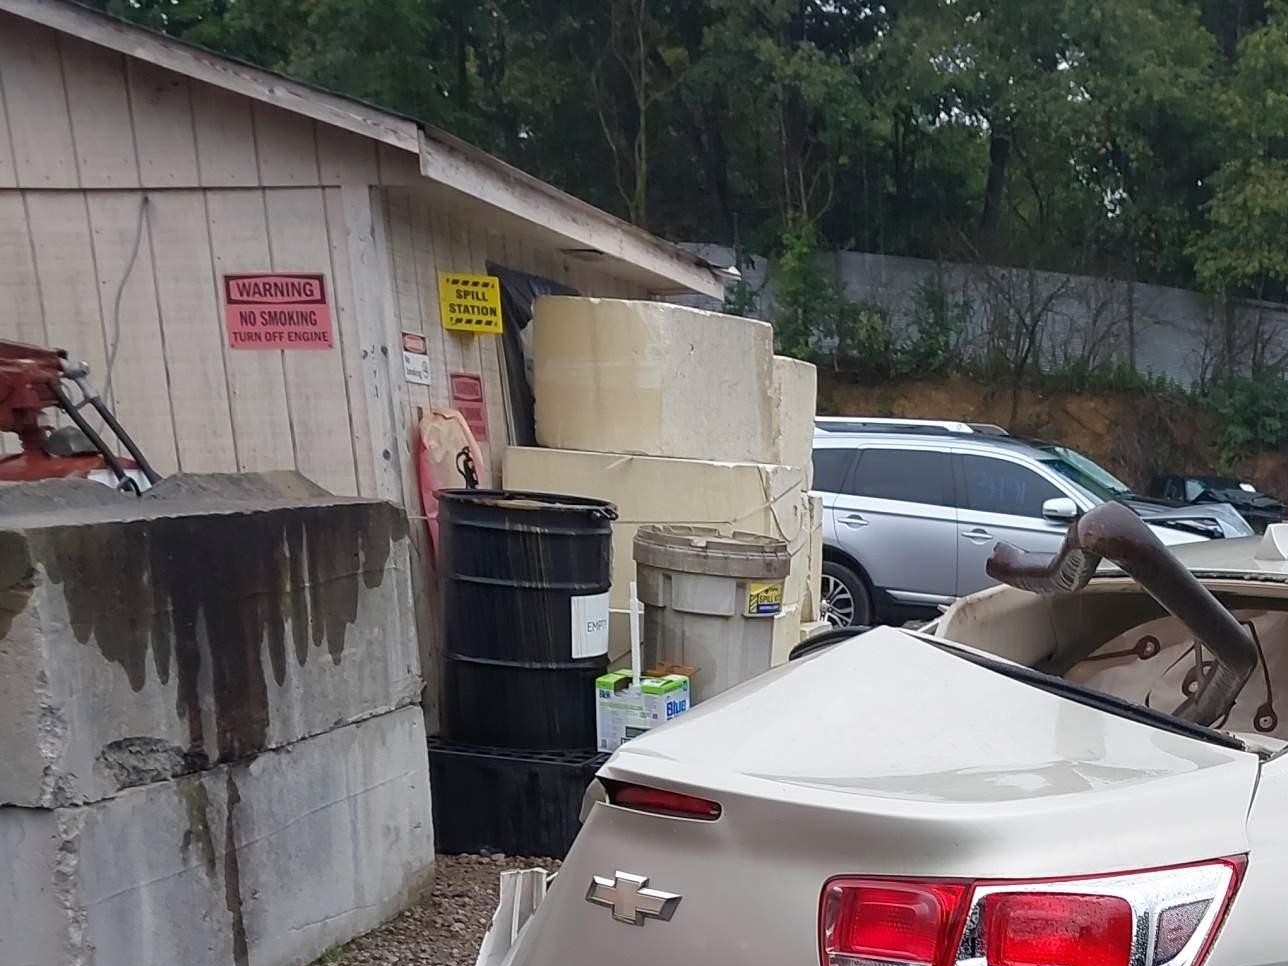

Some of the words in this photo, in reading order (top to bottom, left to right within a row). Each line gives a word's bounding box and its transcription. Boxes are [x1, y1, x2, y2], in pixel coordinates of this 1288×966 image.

[236, 281, 315, 298] WARNING
[455, 288, 489, 302] SPILL
[448, 302, 497, 317] STATION
[239, 310, 257, 327] NO
[260, 310, 318, 327] SMOKING
[232, 331, 262, 342] TURN
[264, 331, 284, 342] OFF
[287, 331, 329, 342] ENGINE
[666, 699, 687, 717] Blue
